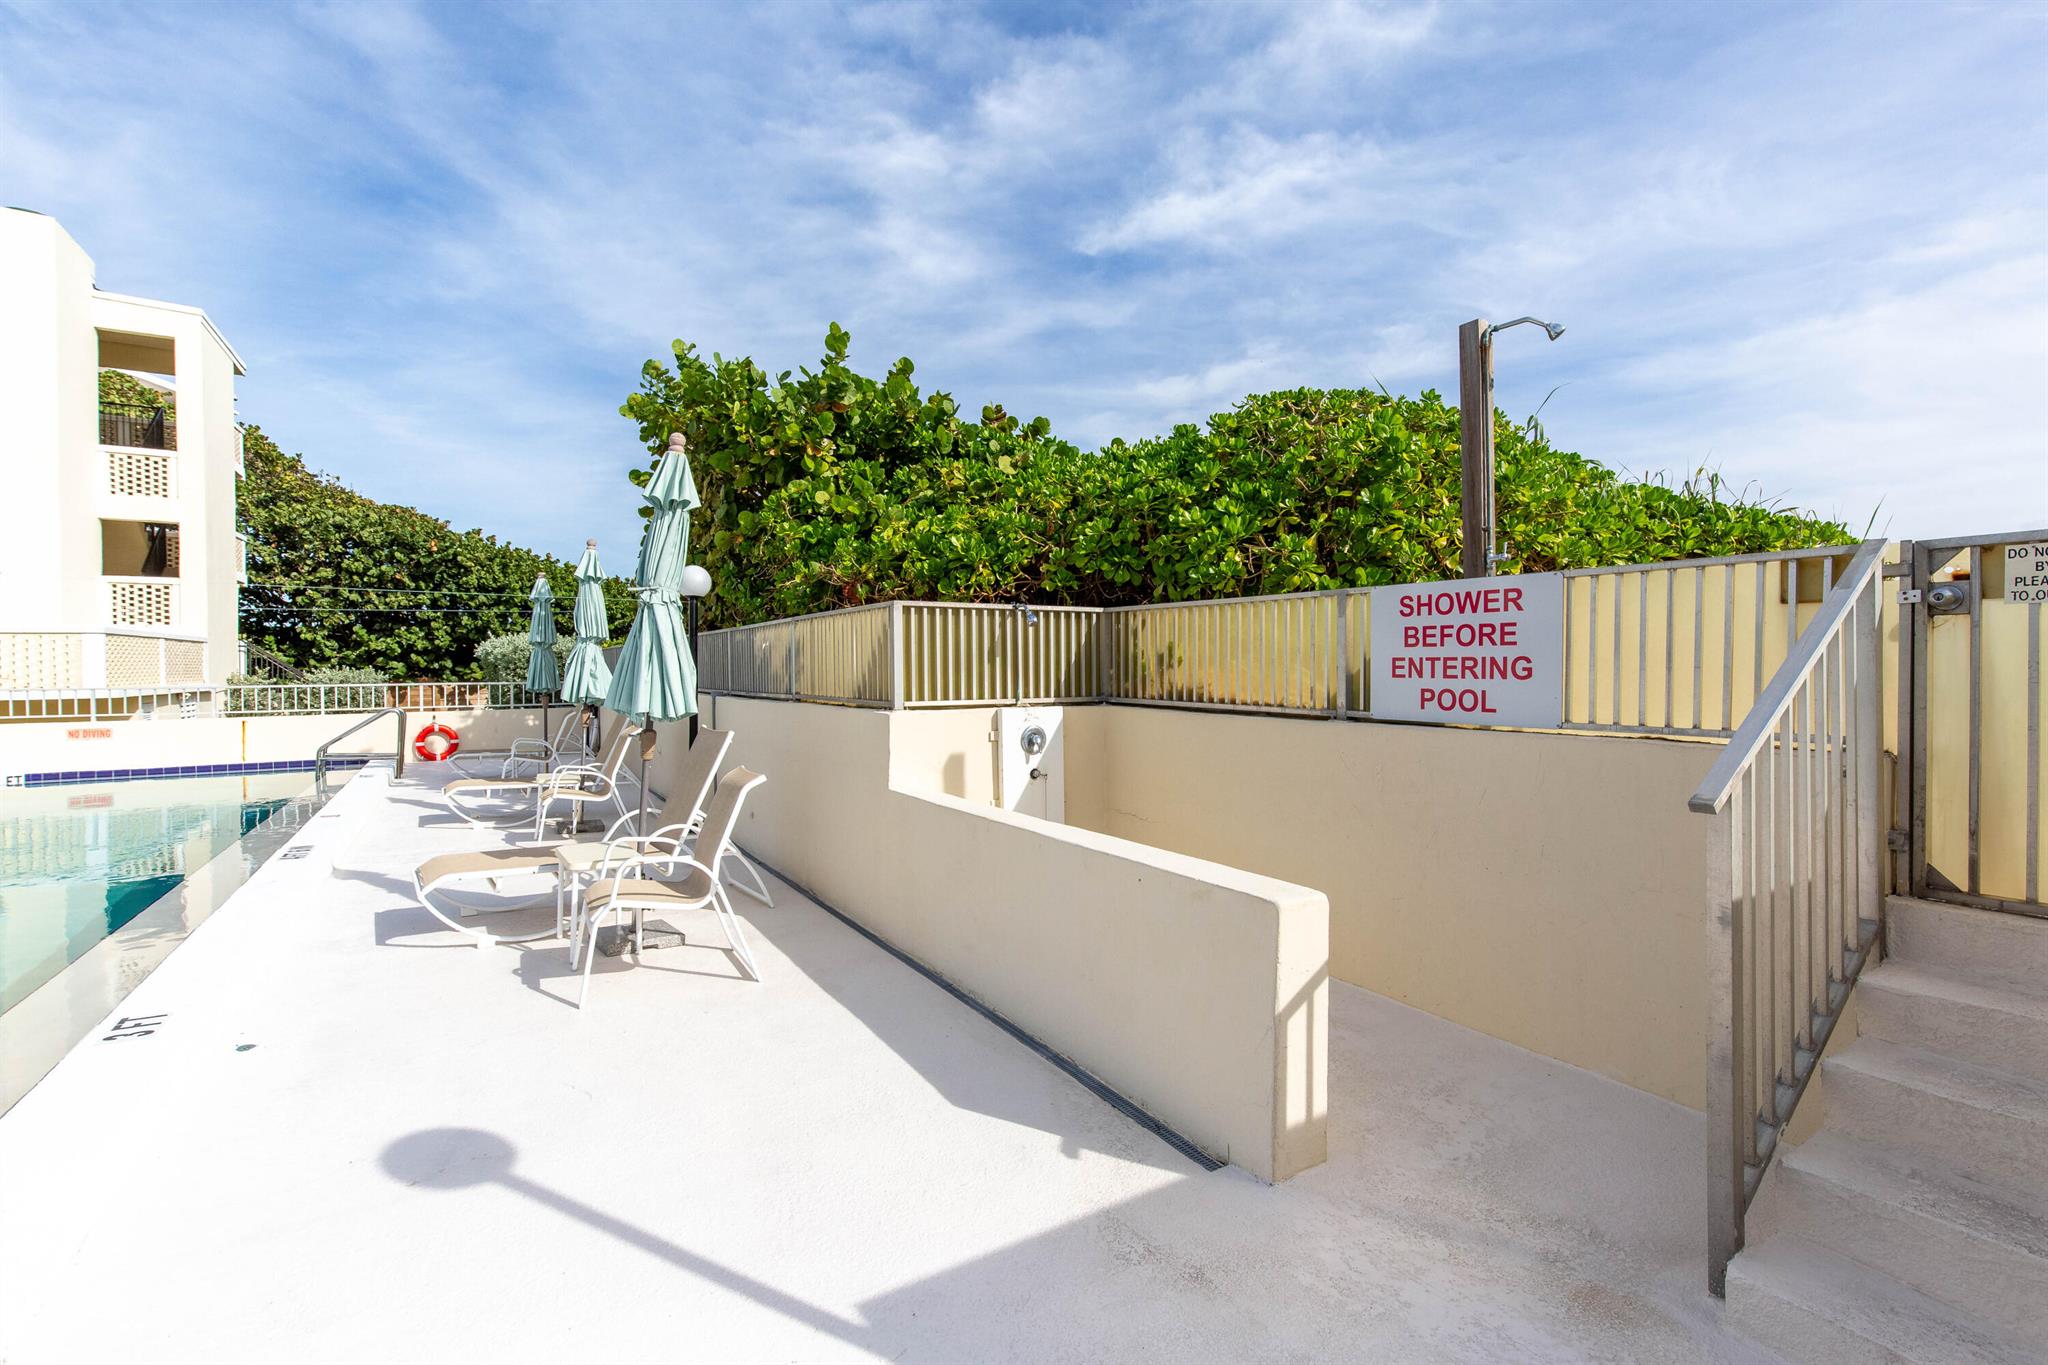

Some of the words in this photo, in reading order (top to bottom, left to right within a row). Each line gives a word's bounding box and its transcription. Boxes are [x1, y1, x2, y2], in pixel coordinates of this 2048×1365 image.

[2008, 548, 2028, 559] DO
[2034, 546, 2048, 557] N
[1399, 587, 1524, 617] SHOWER
[2011, 590, 2029, 601] TO
[2036, 589, 2048, 600] O
[1404, 621, 1518, 648] BEFORE
[1391, 655, 1533, 681] ENTERING
[1420, 688, 1497, 713] POOL
[68, 730, 80, 738] NO
[82, 728, 111, 738] DIVING
